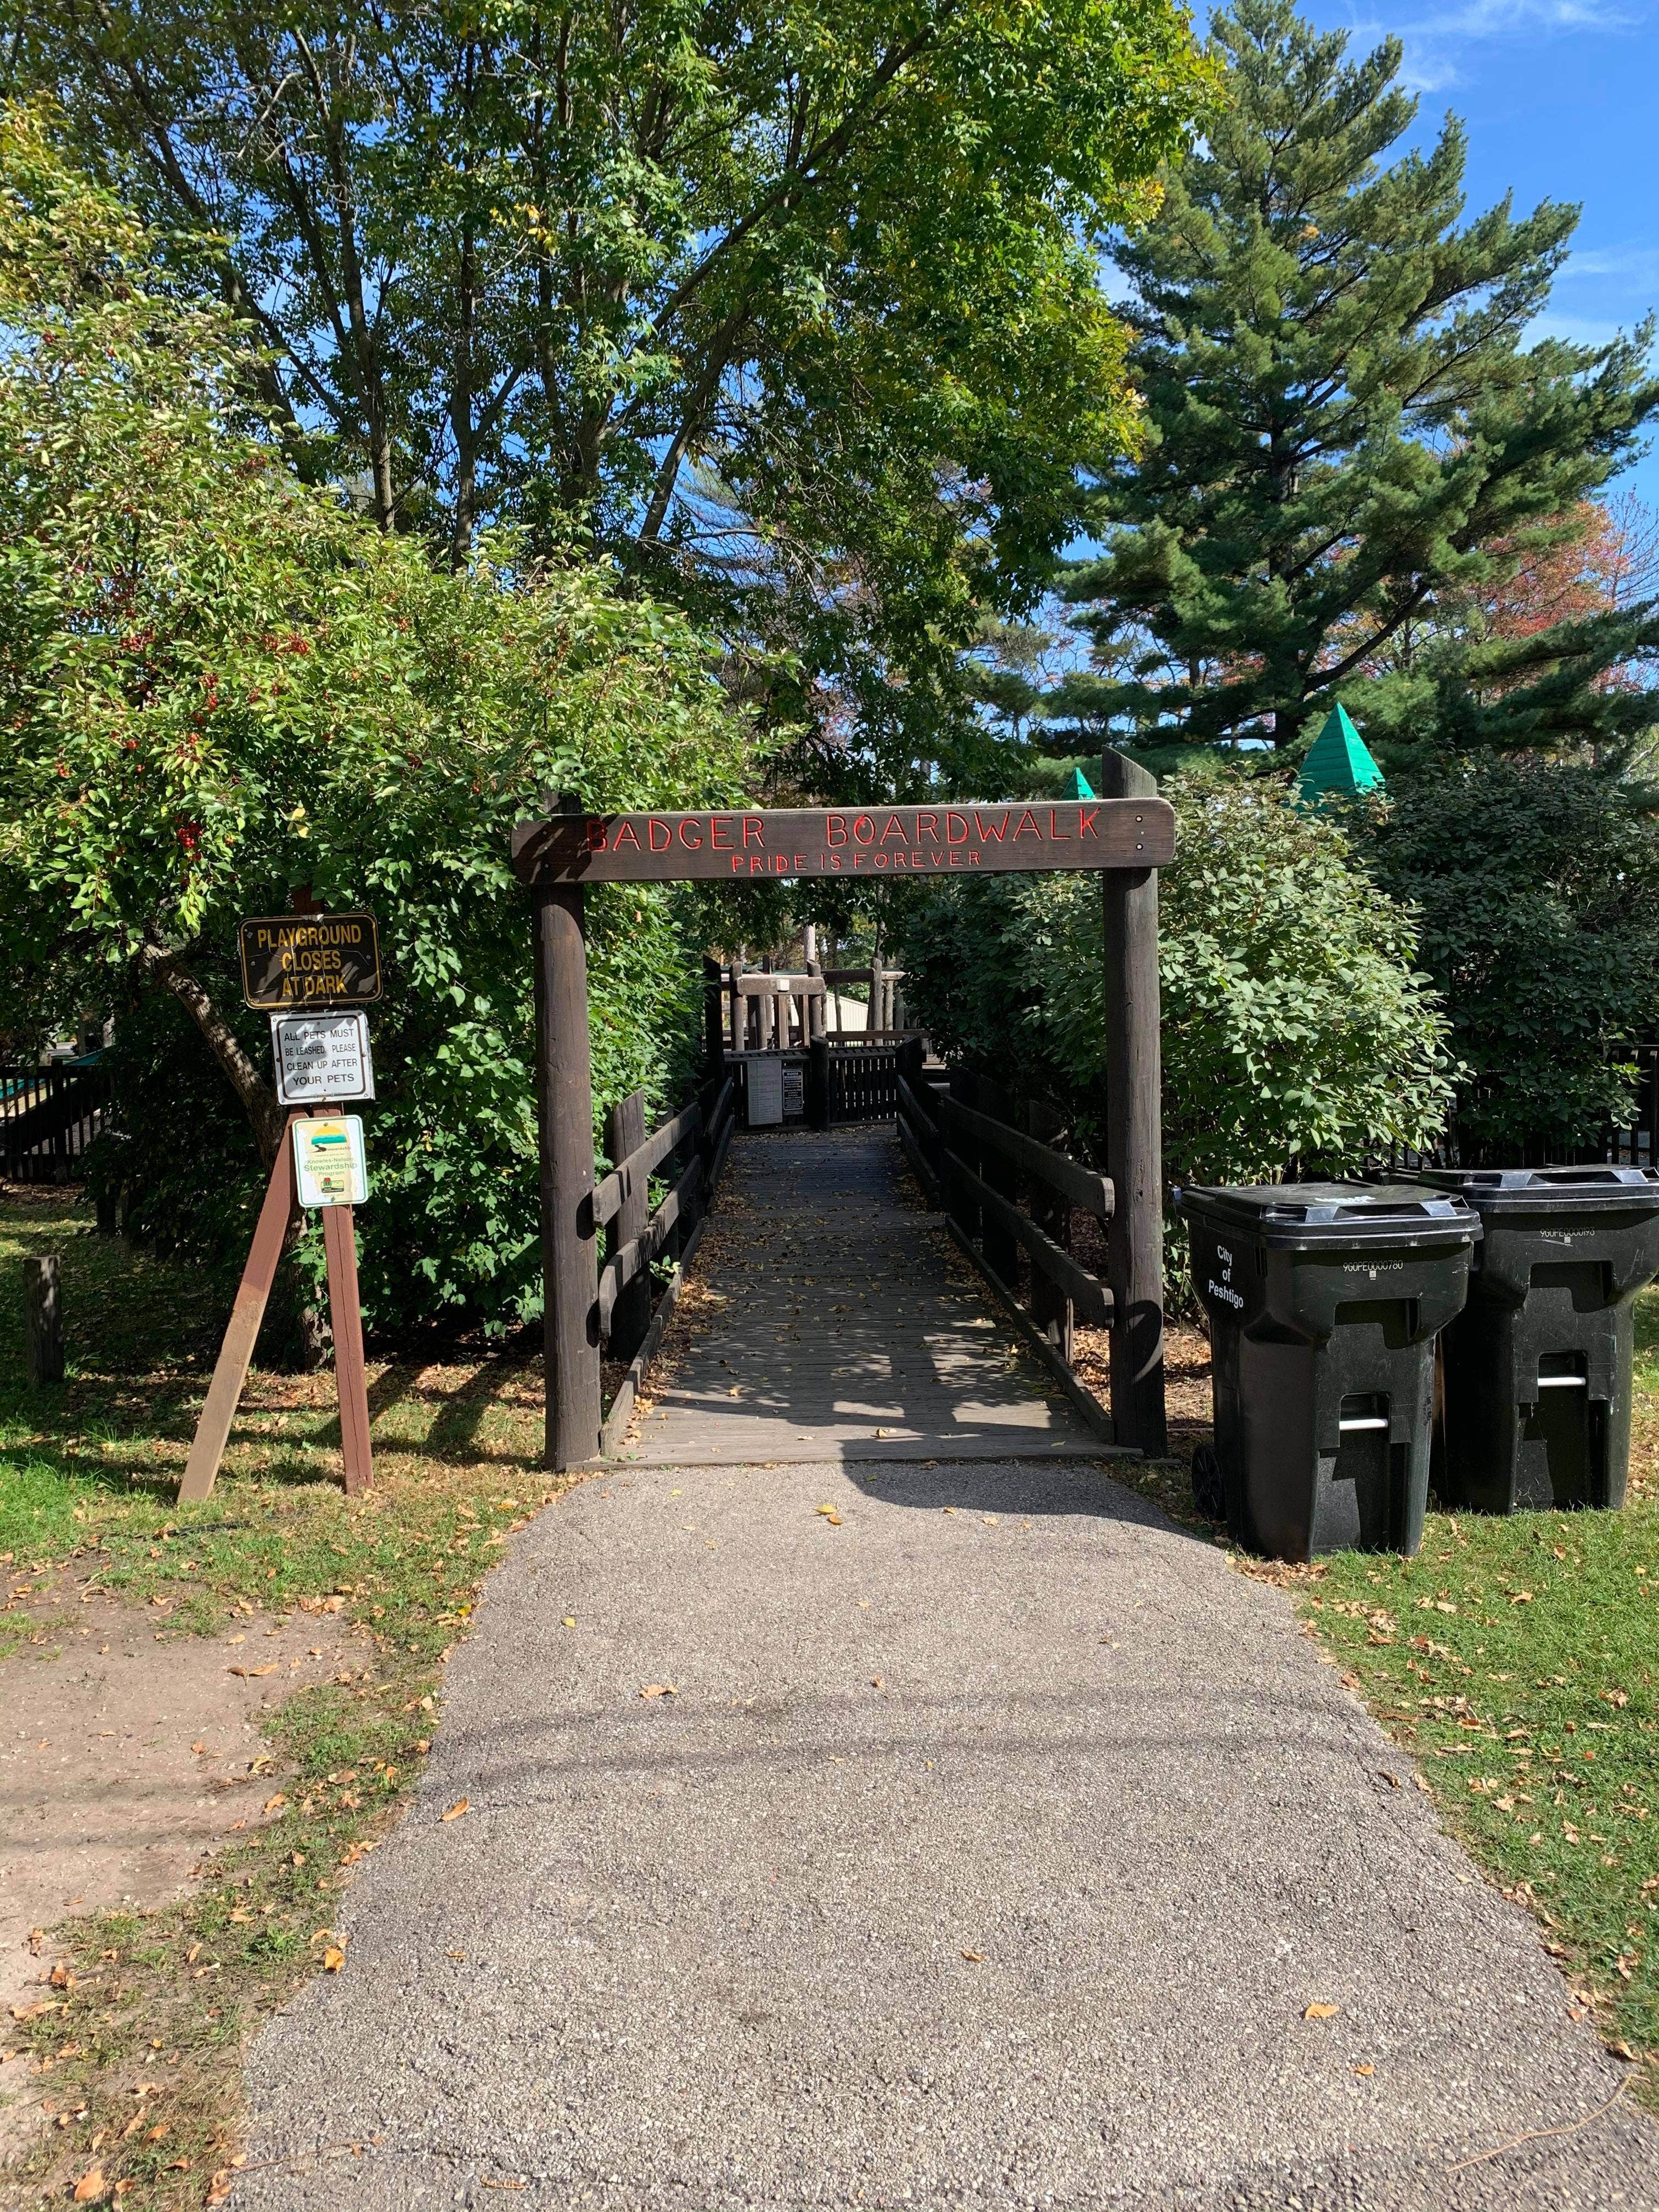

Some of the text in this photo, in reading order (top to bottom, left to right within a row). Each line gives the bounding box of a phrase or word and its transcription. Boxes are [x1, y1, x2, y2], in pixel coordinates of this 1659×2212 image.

[587, 808, 1101, 851] BADGER BOARDWALK
[731, 850, 980, 873] PRIDE IS FOREVER
[258, 924, 361, 948] PLAYGROUND
[282, 950, 341, 972] CLOSES
[282, 975, 348, 997] AT DARK
[284, 1029, 354, 1041] ALL PETS MUST
[285, 1048, 294, 1056] BE
[332, 1043, 356, 1053] PLEASE
[287, 1058, 357, 1071] CLEAN UP AFTER
[293, 1074, 354, 1085] YOUR PETS
[304, 1163, 357, 1171] Stewardship
[1217, 1245, 1232, 1266] City
[1222, 1268, 1231, 1282] of
[1209, 1279, 1244, 1309] Peshtigo
